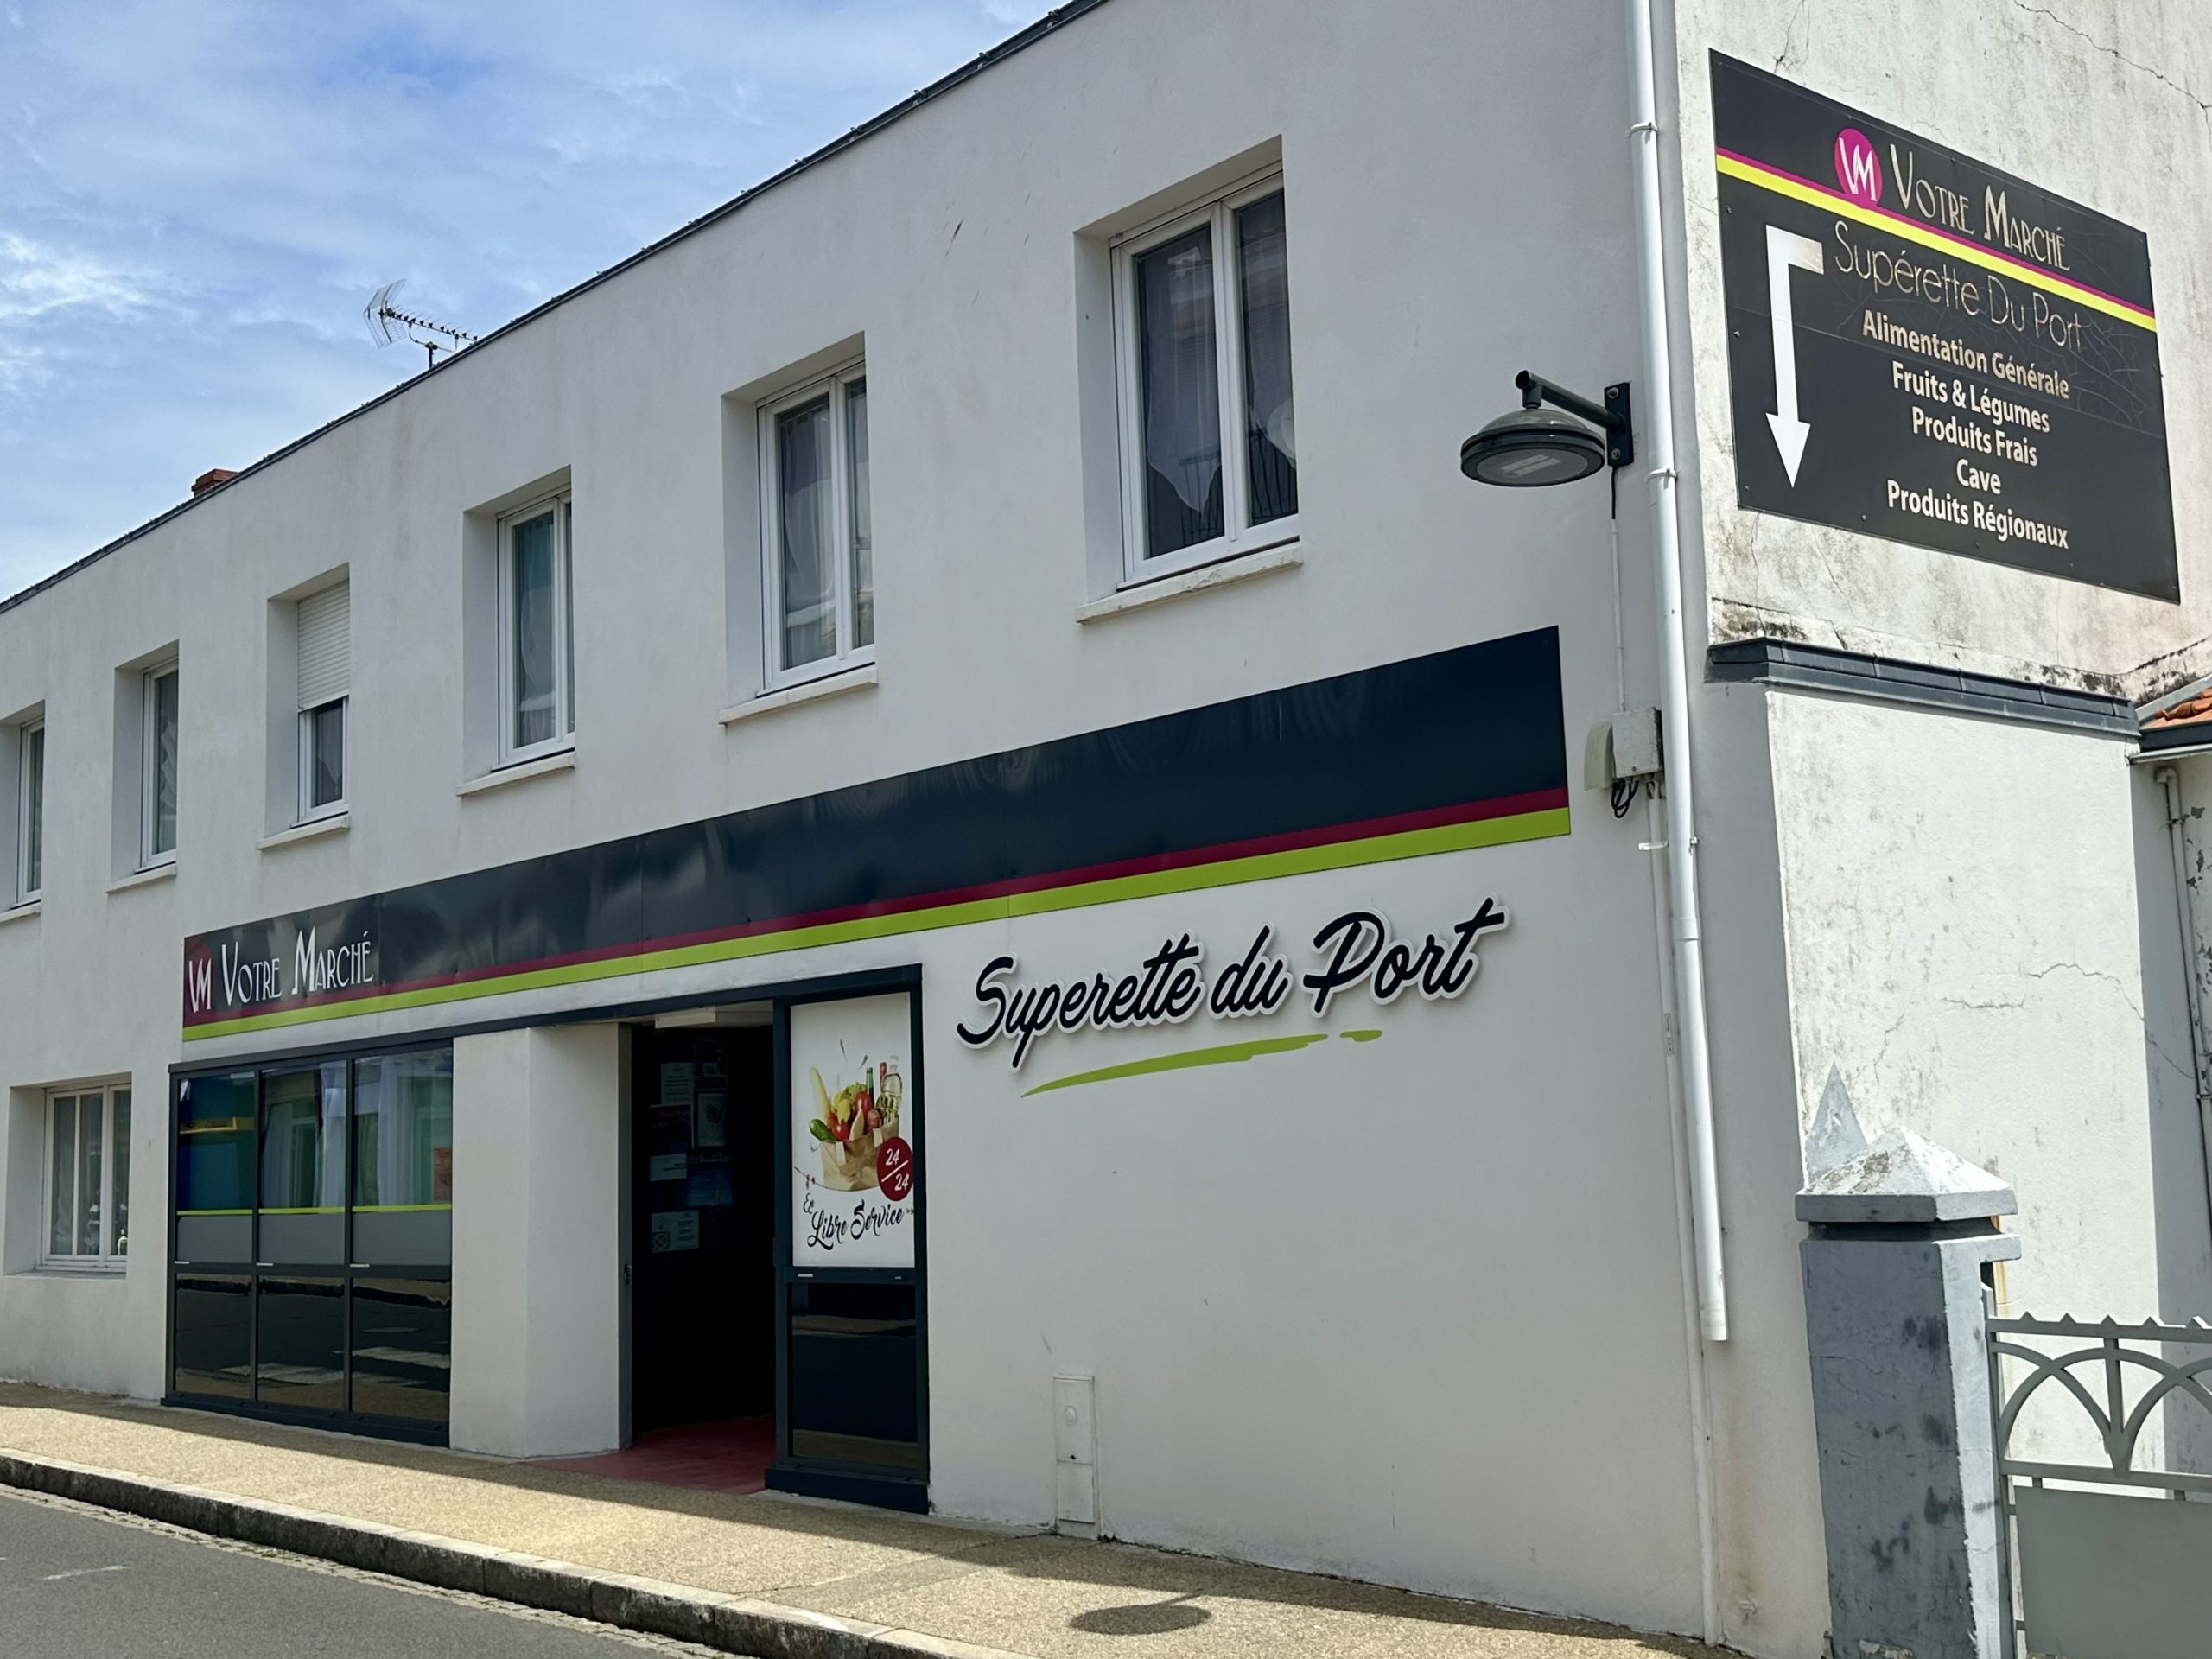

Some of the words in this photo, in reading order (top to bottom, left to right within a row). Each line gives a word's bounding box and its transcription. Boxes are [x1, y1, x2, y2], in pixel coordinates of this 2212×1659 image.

[1890, 143, 1975, 235] VOTRE
[1983, 185, 2070, 272] MARCHÉ
[1834, 220, 1980, 316] Supérette
[1988, 275, 2024, 332] Du
[2033, 292, 2082, 352] Port
[1862, 309, 1987, 373] Alimentation
[1992, 352, 2069, 400] Générale
[1892, 361, 1948, 403] Fruits
[1952, 380, 1967, 408] &
[1970, 384, 2050, 434] Légumes
[1911, 406, 1992, 454] Produits
[1996, 429, 2038, 467] Frais
[1887, 480, 1969, 526] Produits
[1973, 500, 2069, 550] Régionaux
[1956, 459, 2001, 496] Cave
[221, 941, 282, 1006] VOTRE
[291, 925, 374, 995] MARCHÉ
[957, 933, 1202, 1069] Superette
[1211, 925, 1288, 1014] du
[1302, 897, 1505, 1014] Port
[807, 1210, 848, 1250] Libre
[850, 1199, 905, 1240] Service
